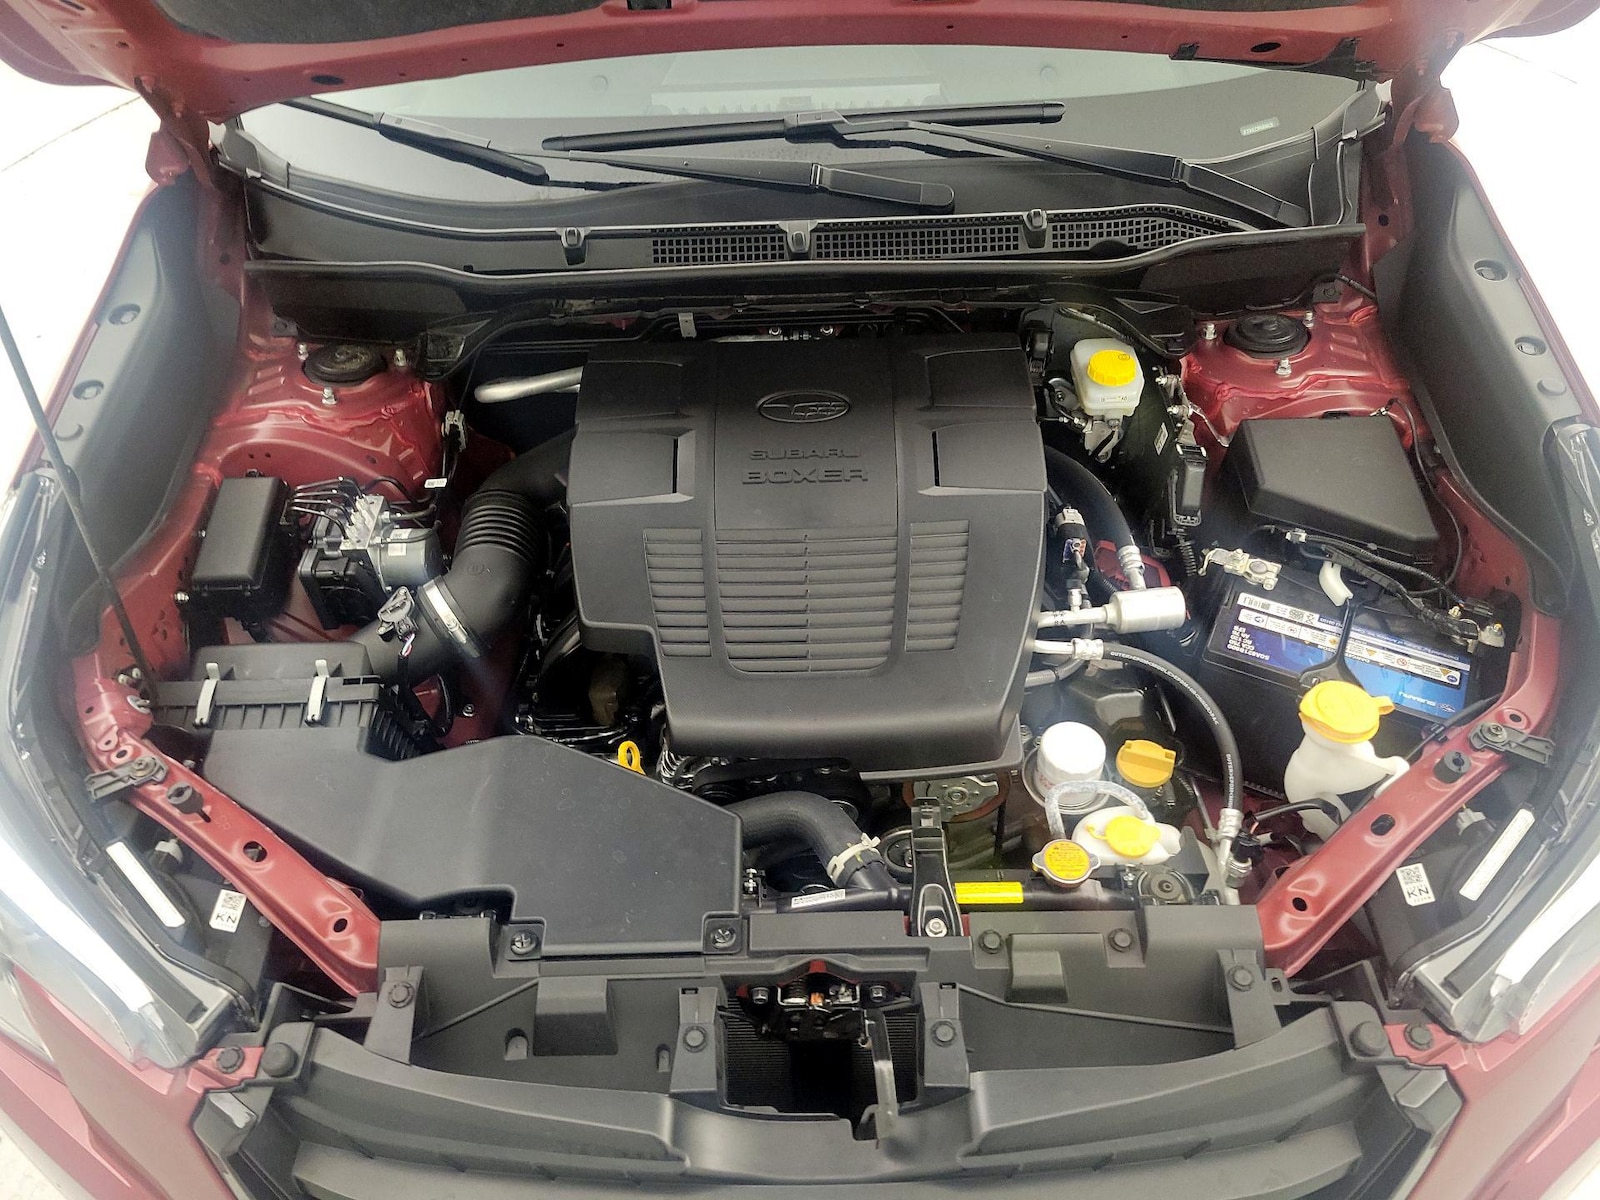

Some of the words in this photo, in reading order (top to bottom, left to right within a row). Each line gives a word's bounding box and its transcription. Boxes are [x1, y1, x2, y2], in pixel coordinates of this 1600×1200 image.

[750, 447, 860, 460] SUBARU
[742, 467, 868, 484] BOXER
[1399, 690, 1436, 706] SUBARU
[215, 912, 237, 924] KN
